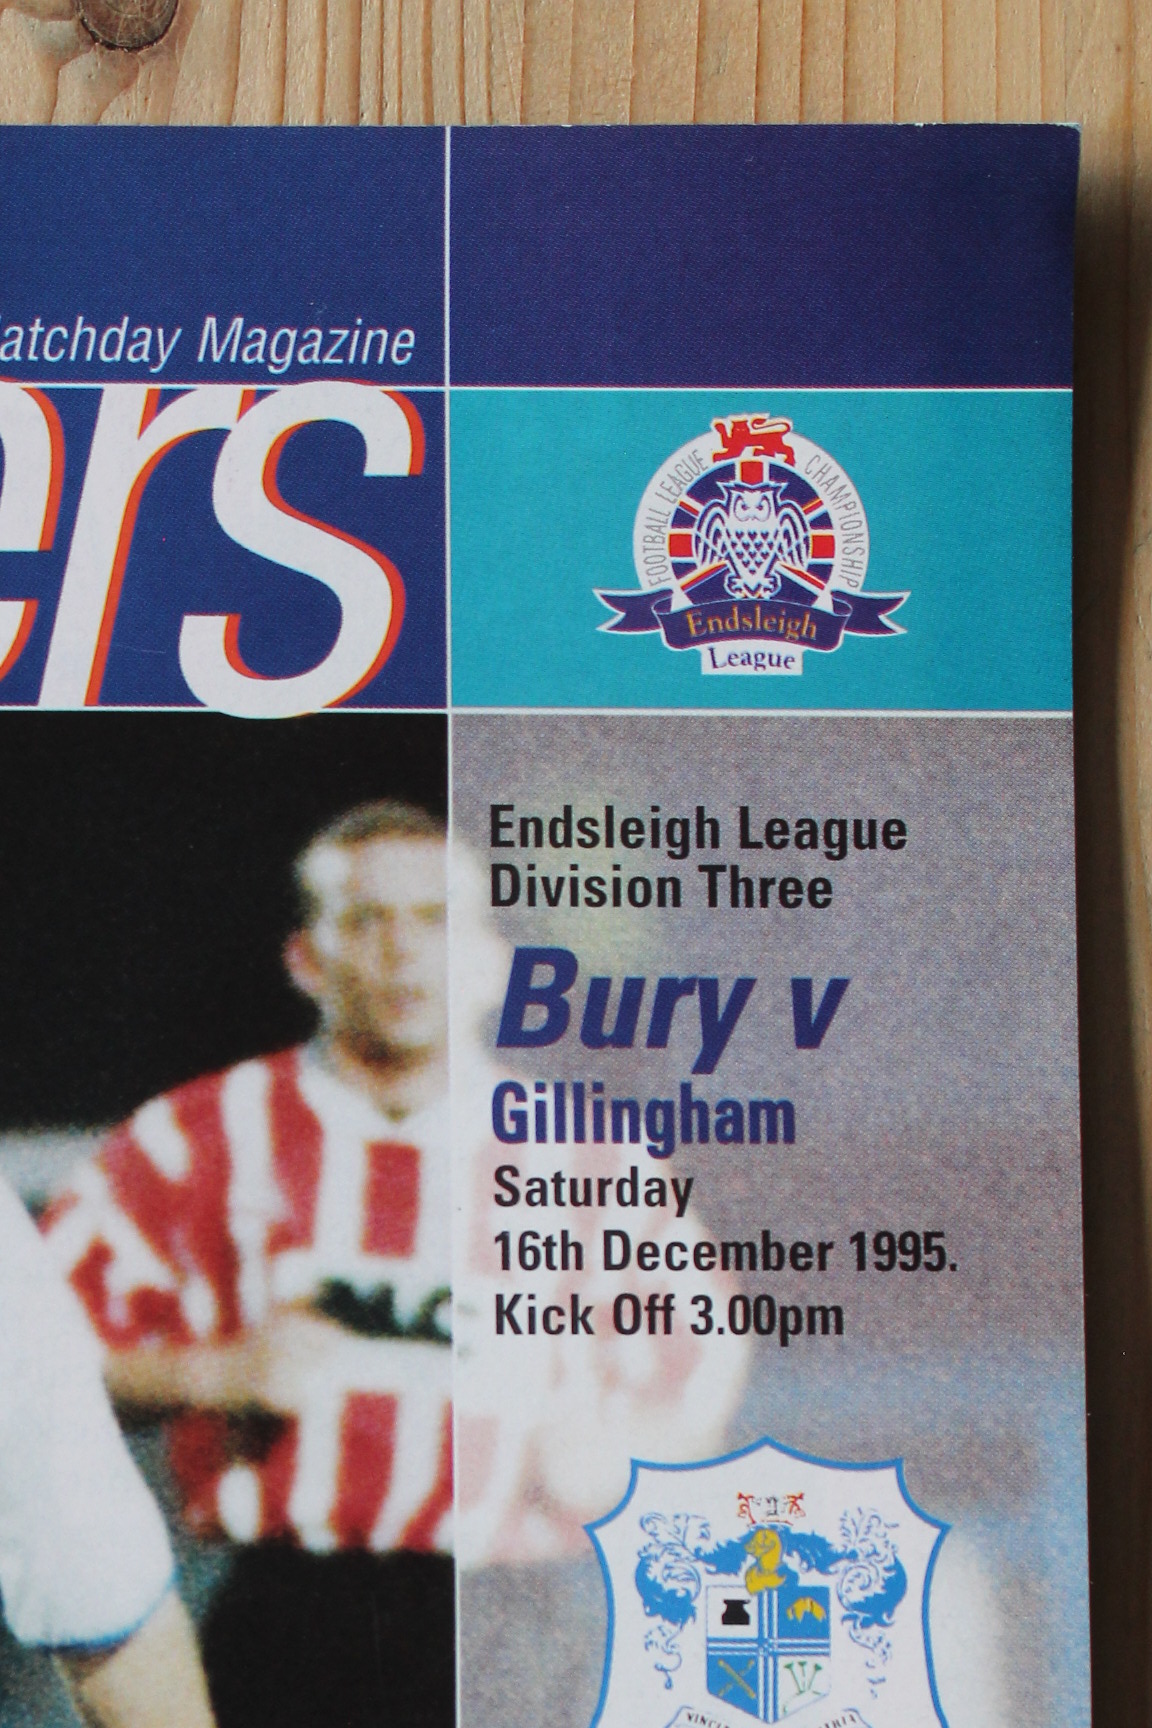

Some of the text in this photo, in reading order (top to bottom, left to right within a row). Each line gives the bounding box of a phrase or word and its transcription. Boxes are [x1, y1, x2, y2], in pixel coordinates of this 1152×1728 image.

[197, 316, 416, 374] Magazine
[642, 449, 709, 587] FOOTBALL LEAGUE
[804, 454, 866, 589] CHAMPIONSHIP
[686, 605, 818, 642] Endsleigh
[708, 646, 796, 672] League
[489, 804, 908, 861] Endsleigh League
[490, 863, 833, 909] Division Three
[496, 946, 850, 1075] Bury v
[491, 1080, 796, 1159] Gillingham
[493, 1165, 694, 1218] Saturday
[494, 1230, 958, 1272] 16th December 1995.
[495, 1294, 595, 1336] Kick
[613, 1294, 676, 1337] Off
[690, 1295, 845, 1347] 3.00pm
